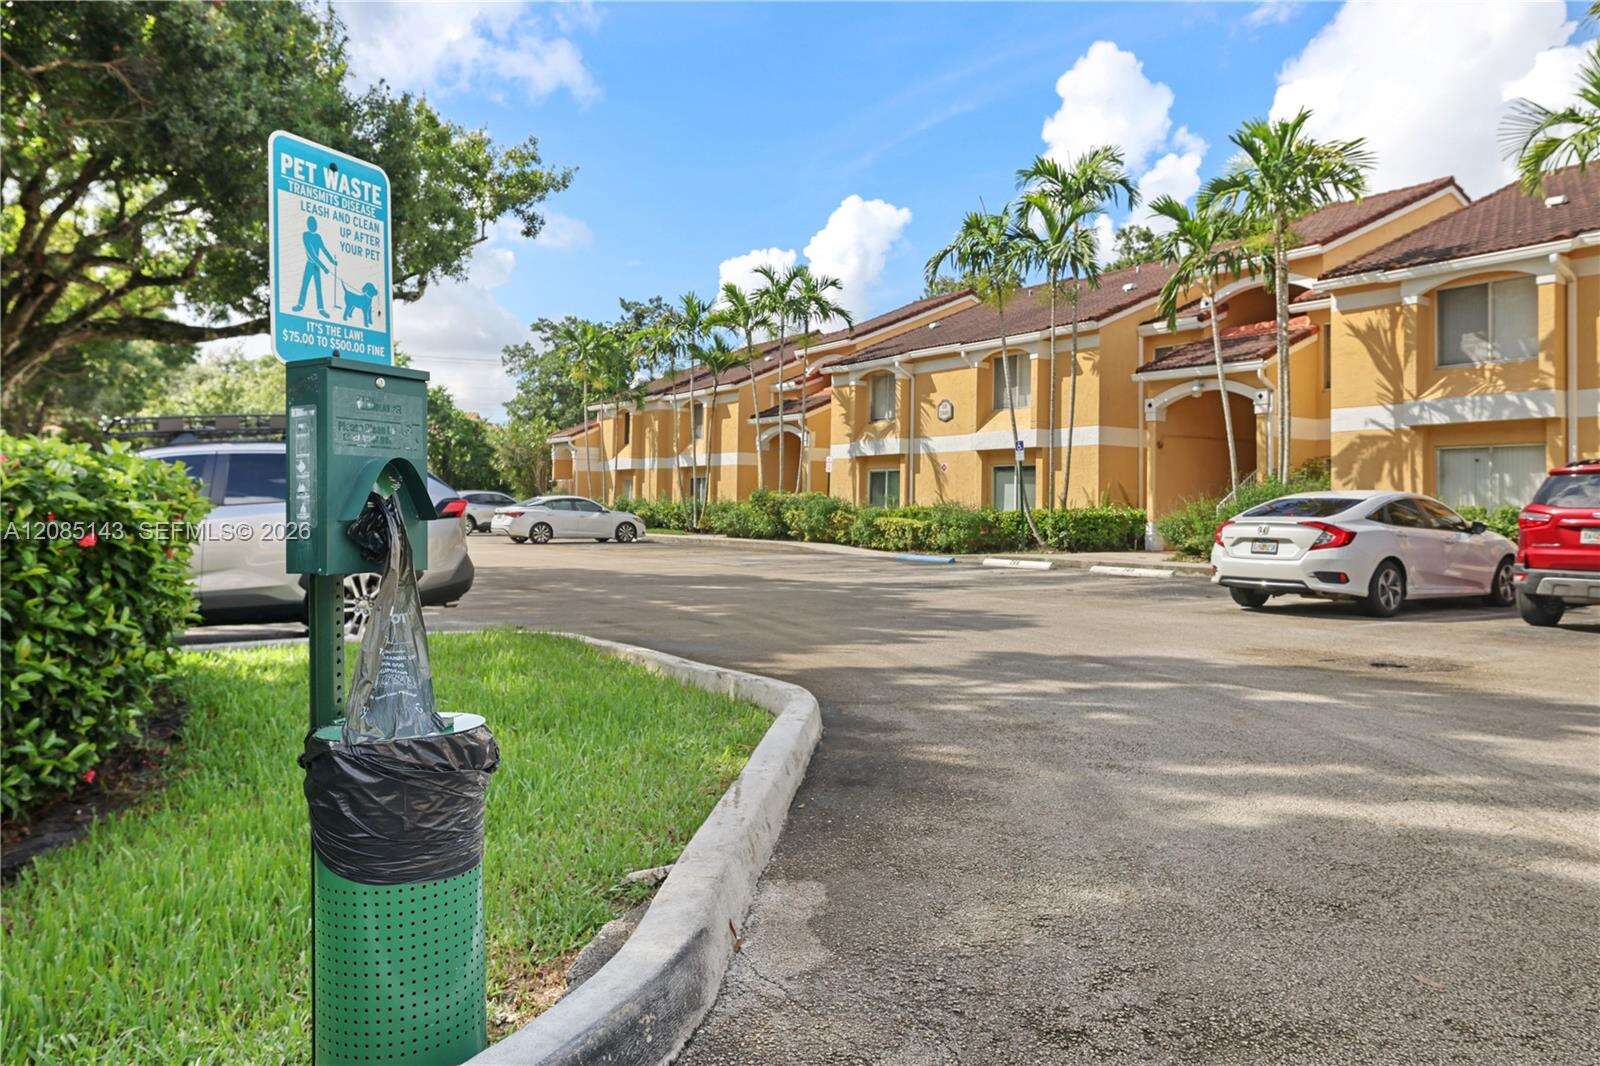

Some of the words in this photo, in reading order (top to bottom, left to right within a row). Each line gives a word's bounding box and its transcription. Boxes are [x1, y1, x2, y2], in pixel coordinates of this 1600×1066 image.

[280, 152, 317, 184] PET
[323, 166, 382, 206] WASTE
[288, 180, 339, 207] TRANSMITS
[341, 198, 376, 218] DISEASE
[301, 200, 329, 218] LEASH
[333, 210, 351, 224] AND
[353, 216, 380, 233] CLEAN
[340, 227, 351, 238] UP
[354, 231, 380, 247] AFTER
[340, 241, 363, 257] YOUR
[365, 249, 380, 261] PET
[282, 328, 314, 345] $75.00
[317, 336, 328, 347] TO
[330, 338, 364, 353] $500.00
[367, 344, 385, 357] FINE
[306, 321, 323, 334] IT'S
[325, 325, 341, 337] THE
[344, 328, 364, 341] LAW!
